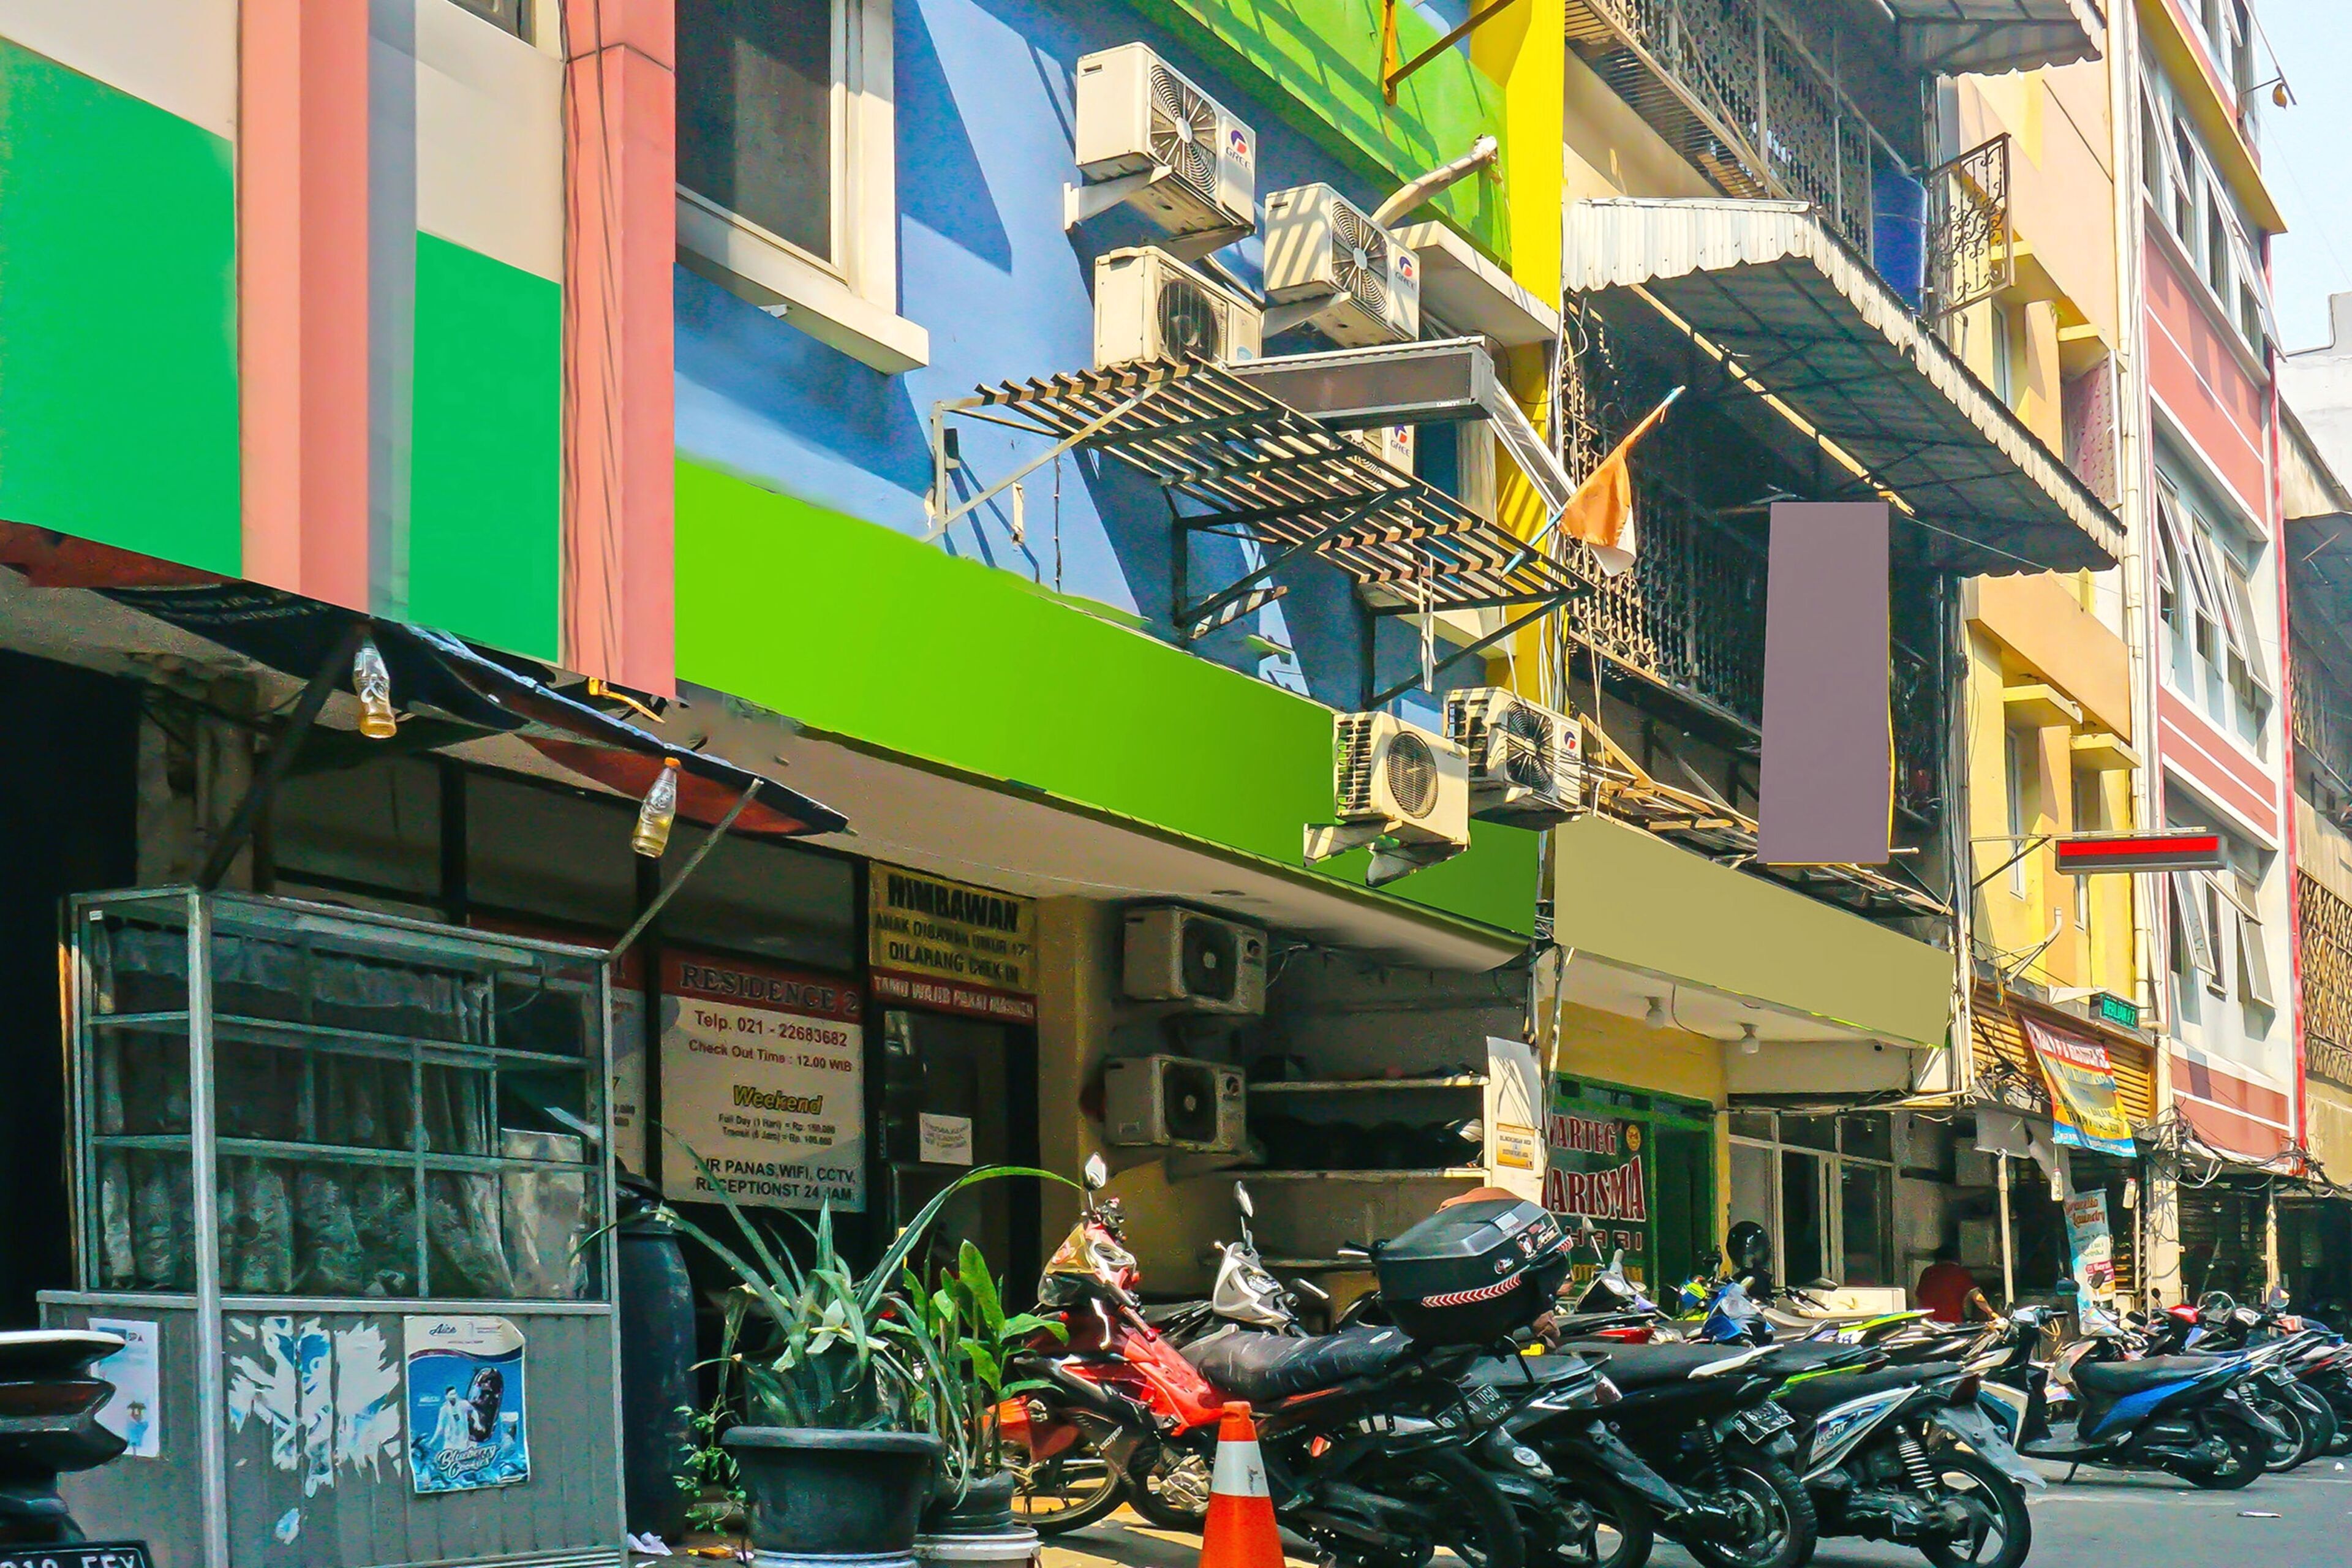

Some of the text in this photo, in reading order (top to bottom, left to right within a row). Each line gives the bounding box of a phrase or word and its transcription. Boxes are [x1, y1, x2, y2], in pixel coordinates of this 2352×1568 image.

[1226, 146, 1251, 171] GREE
[1390, 439, 1411, 458] GREE
[889, 941, 965, 973] DILARANG
[679, 963, 836, 1011] RESIDENCE
[694, 1010, 733, 1033] Telp.
[737, 1017, 763, 1035] 021
[778, 1022, 848, 1047] 22683682
[688, 1039, 728, 1056] Check
[731, 1044, 753, 1059] Out
[756, 1048, 785, 1064] Time
[797, 1055, 826, 1069] 12.00
[829, 1058, 852, 1072] WIB
[733, 1084, 824, 1115] Weekend
[736, 1115, 751, 1128] Day
[804, 1185, 819, 1199] 24
[429, 1322, 458, 1336] Aice
[1476, 1385, 1500, 1404] UGU
[437, 1442, 498, 1470] Blueberry
